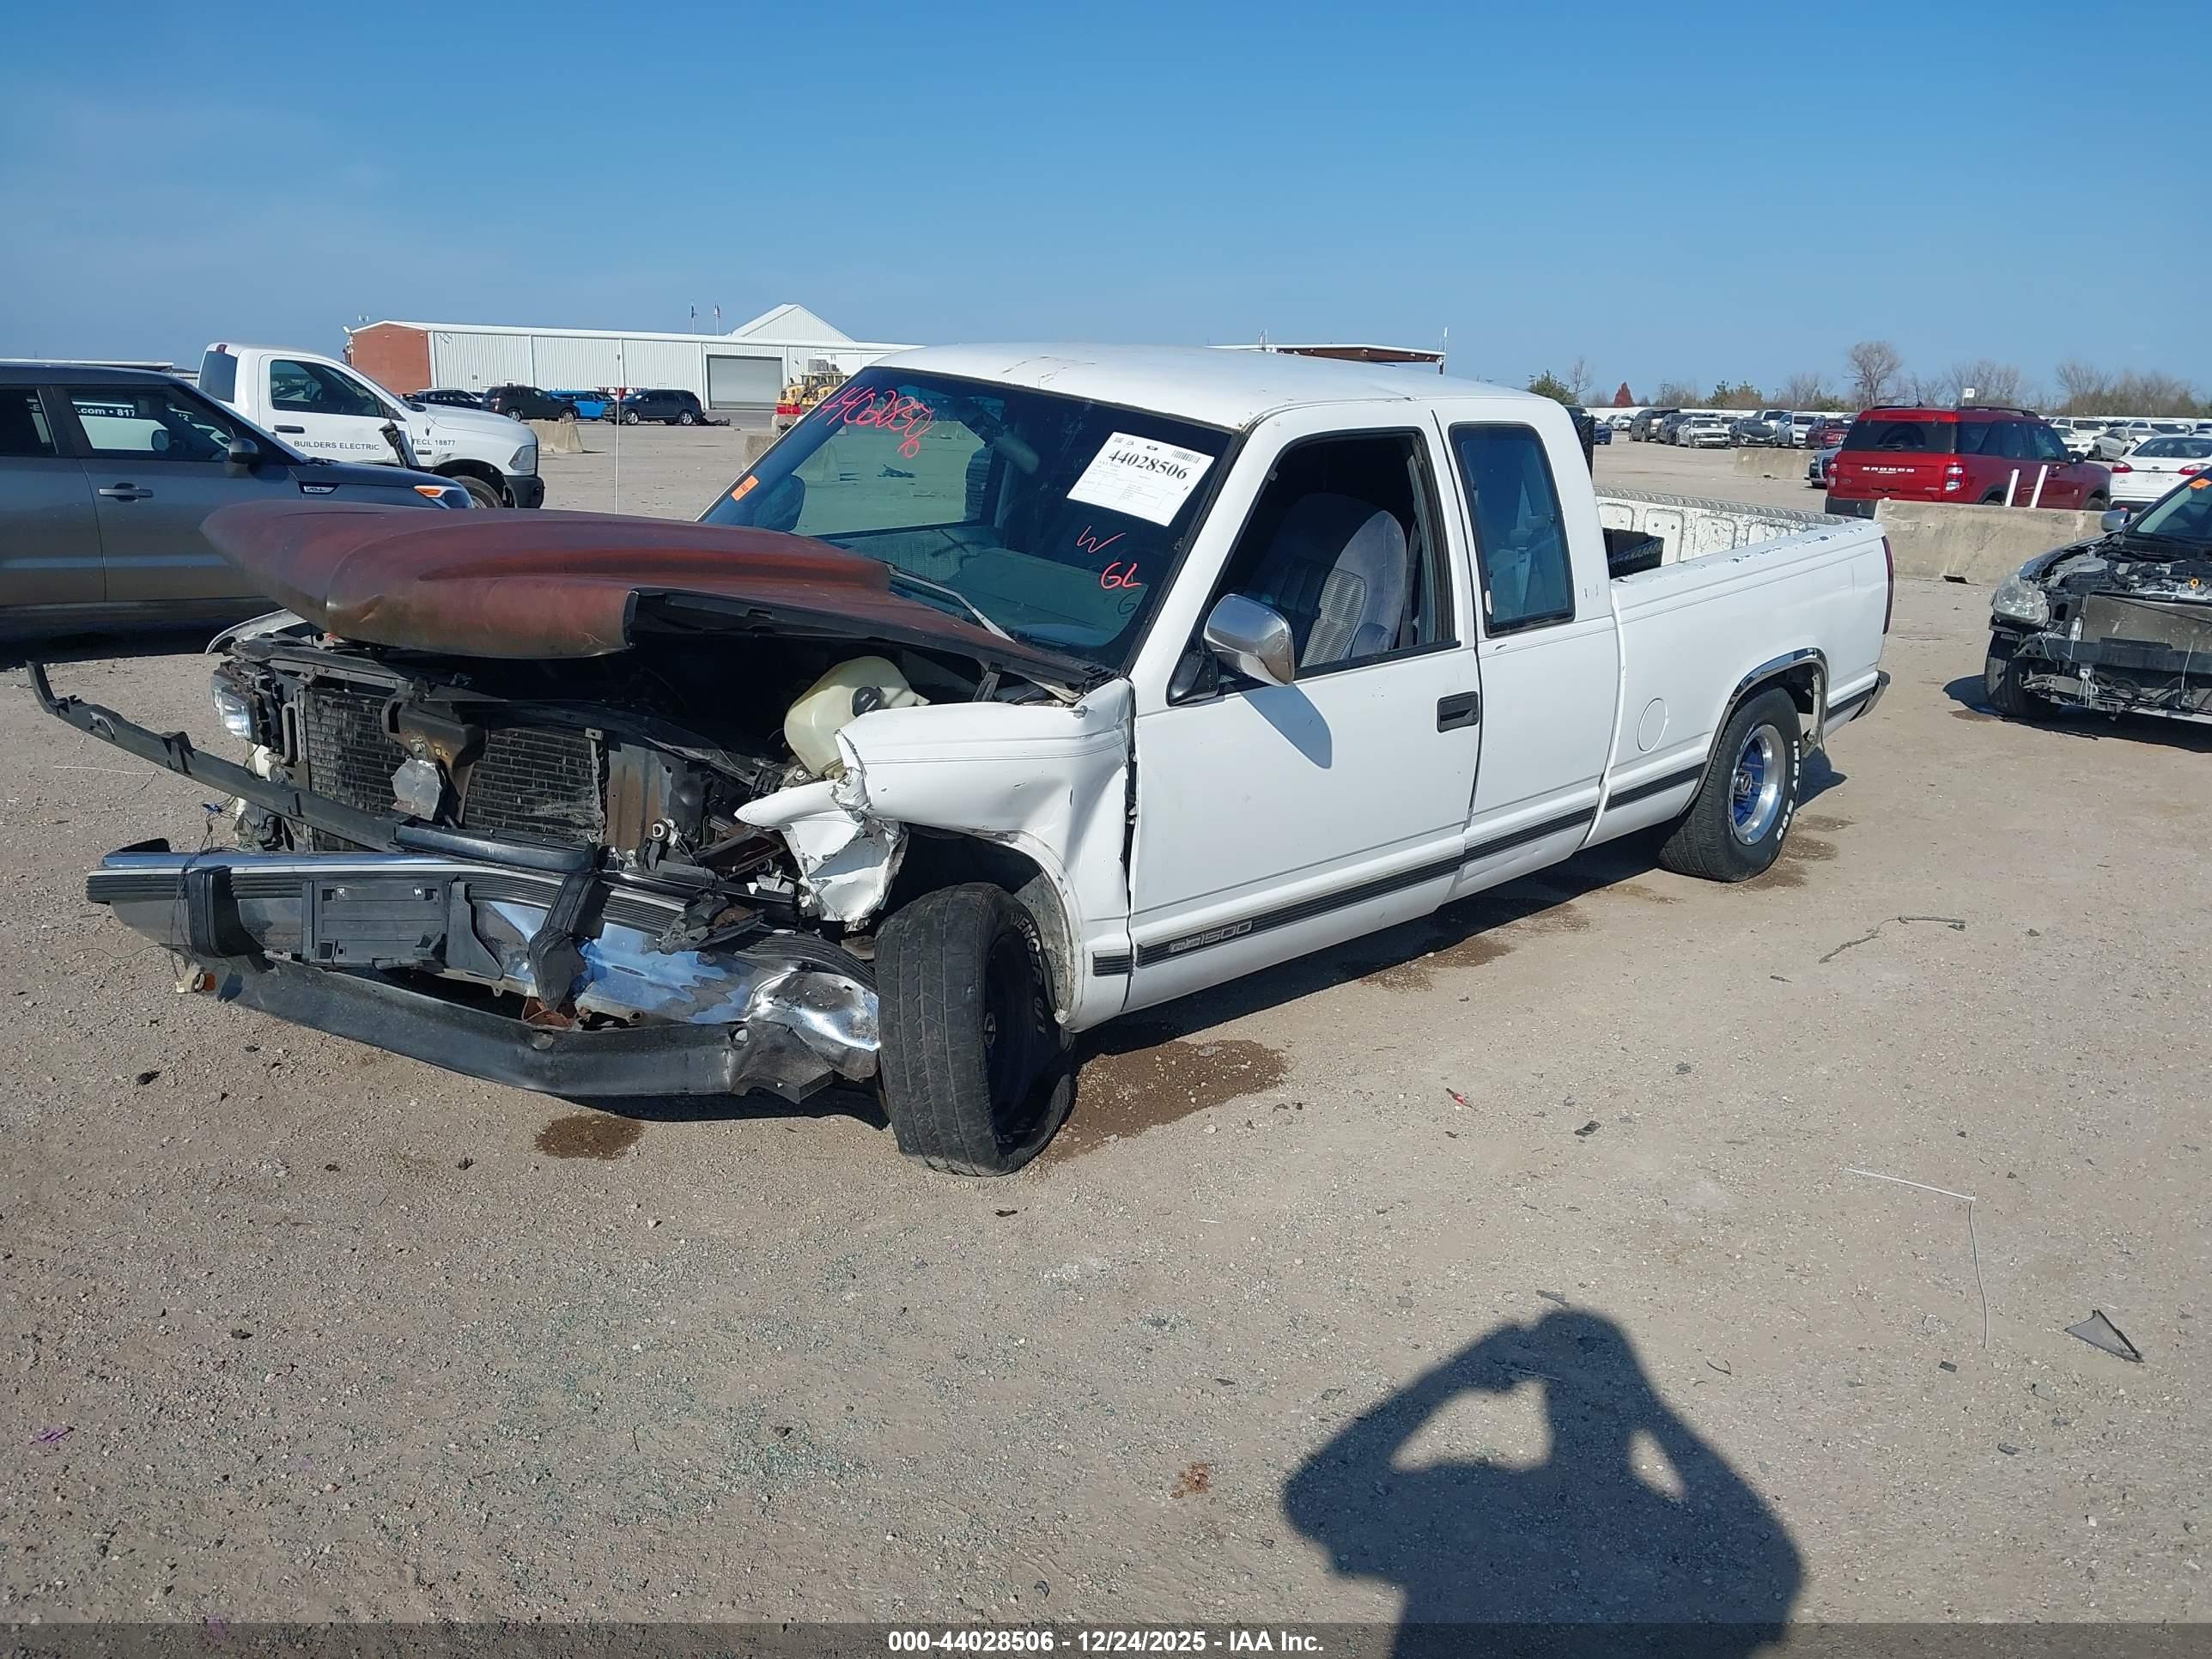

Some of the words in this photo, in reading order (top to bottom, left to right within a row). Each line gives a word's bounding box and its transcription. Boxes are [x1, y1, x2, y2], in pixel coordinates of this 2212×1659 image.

[294, 441, 337, 449] BUILDERS
[339, 442, 380, 451] ELECTRIC
[1108, 449, 1192, 480] 44028506
[1076, 525, 1127, 554] W
[1776, 799, 1795, 842] 500
